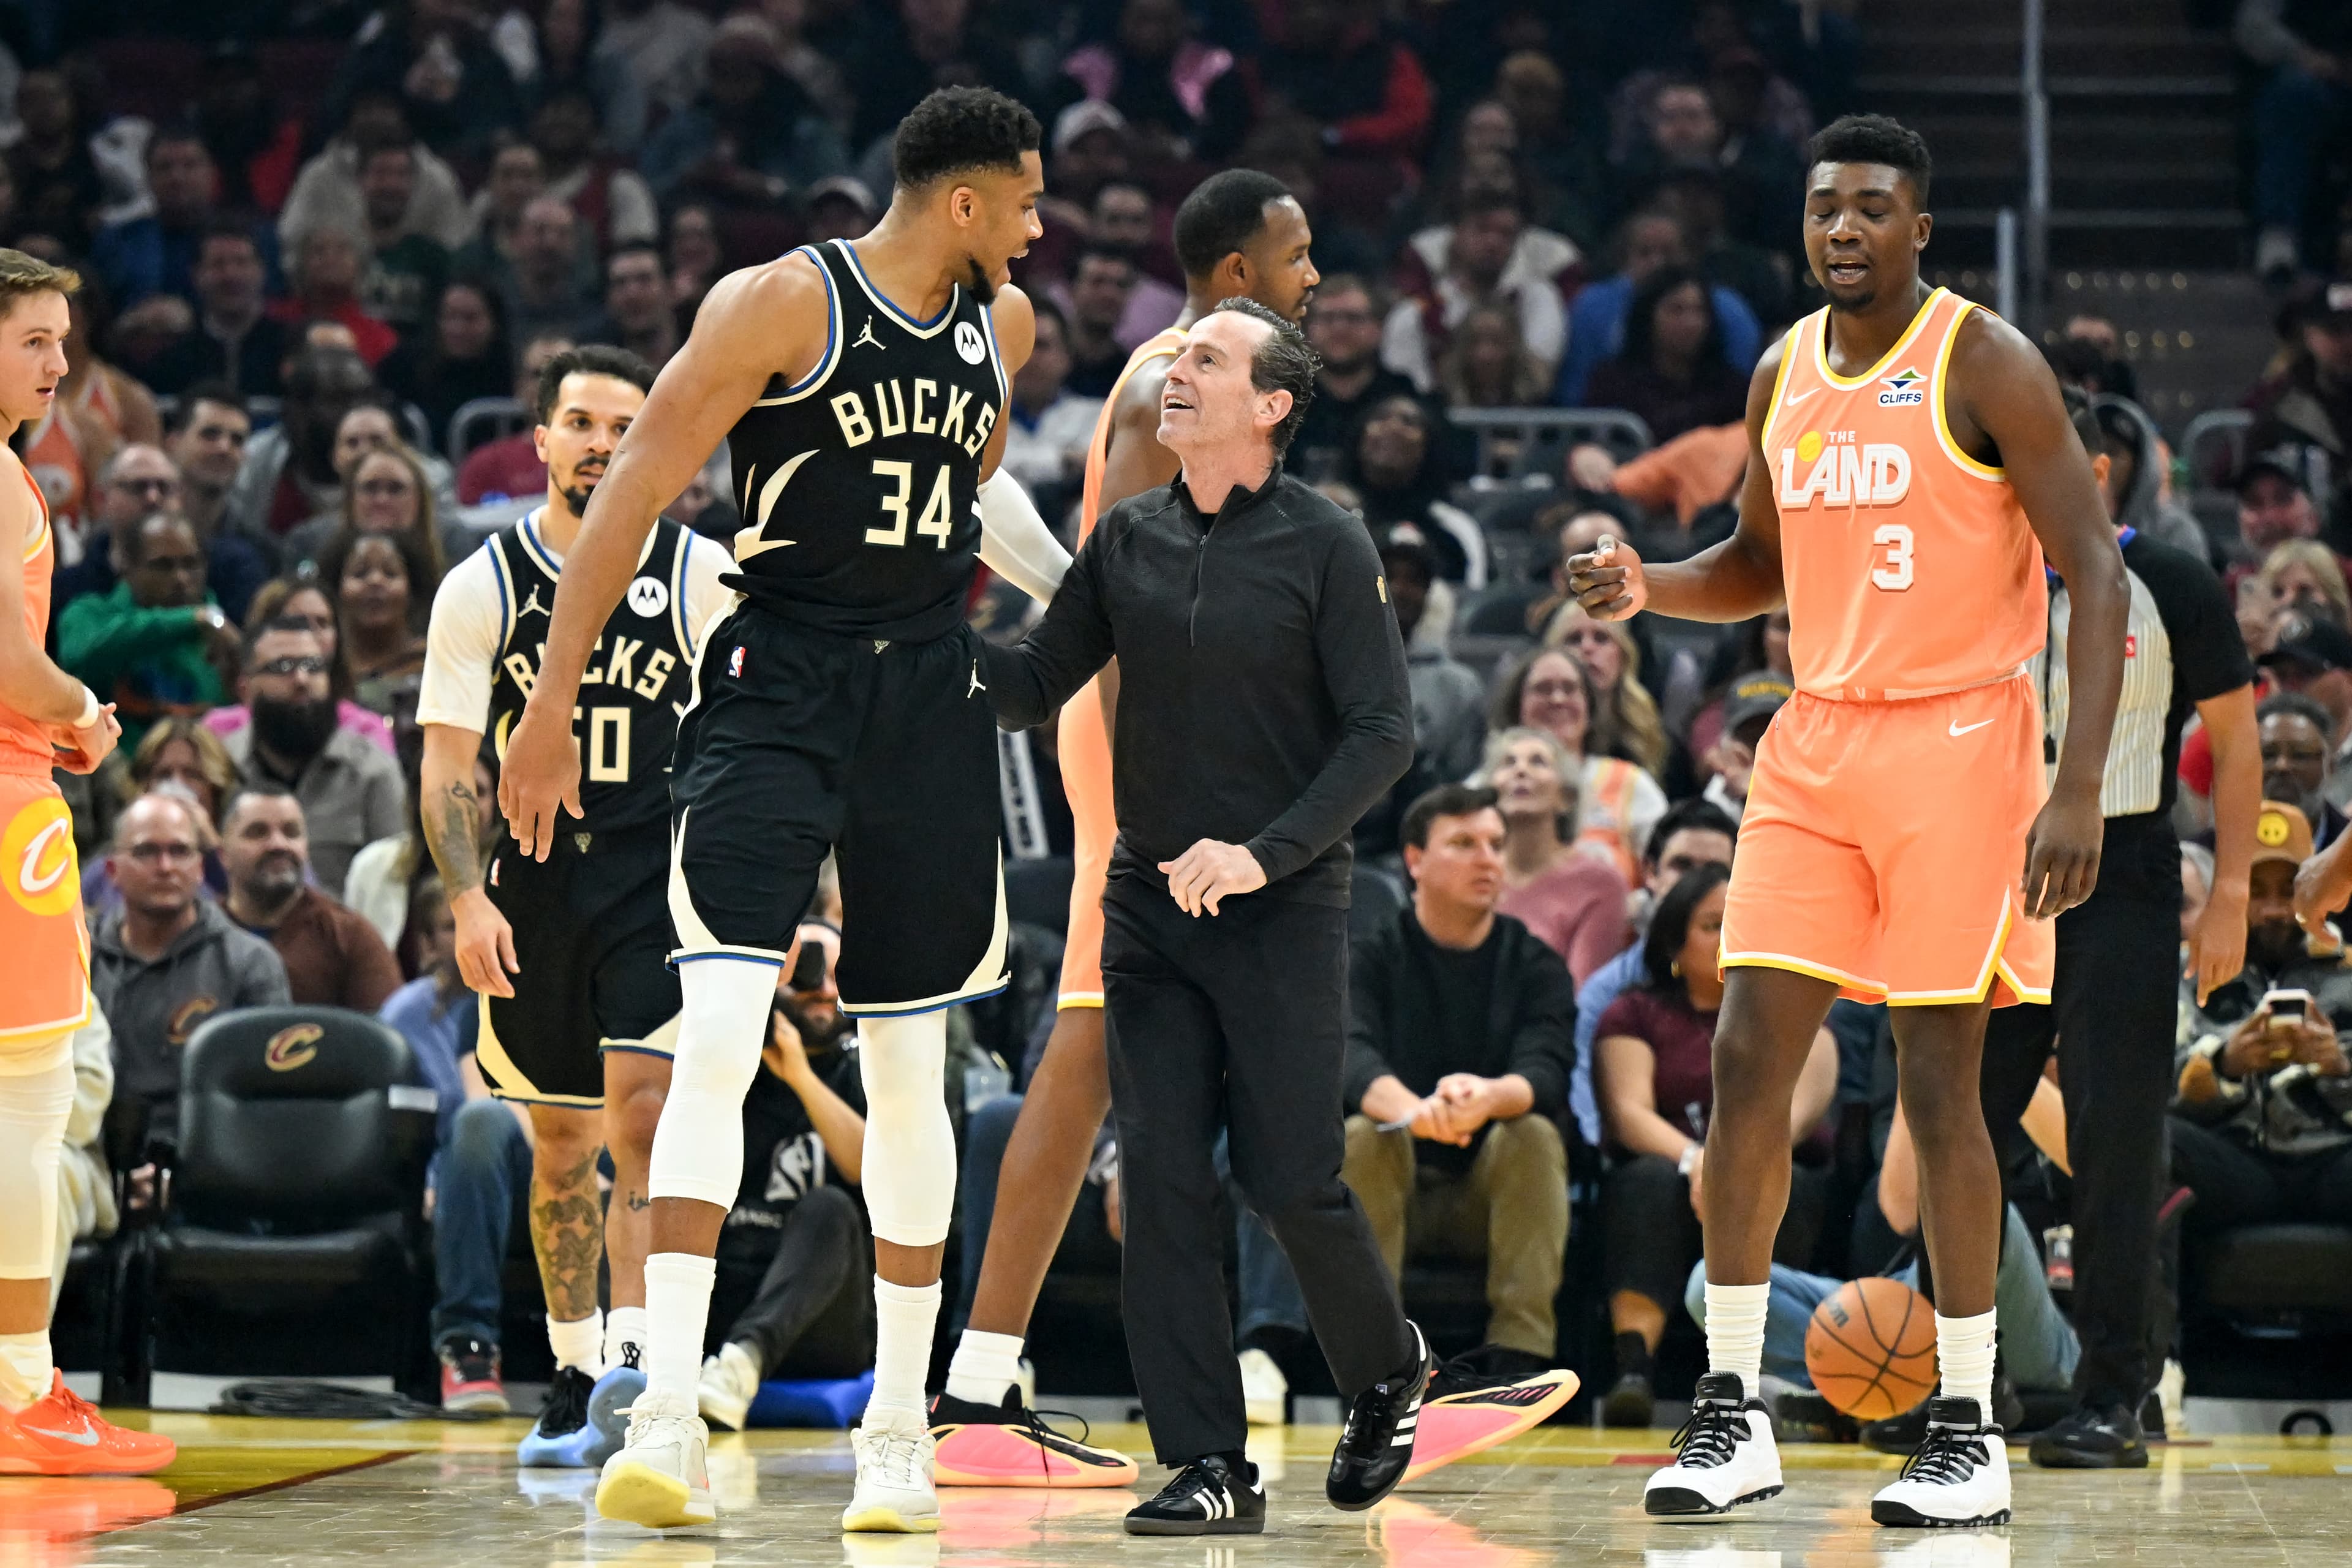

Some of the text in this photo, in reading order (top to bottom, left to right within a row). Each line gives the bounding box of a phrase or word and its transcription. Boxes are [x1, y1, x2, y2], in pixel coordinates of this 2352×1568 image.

[830, 377, 997, 459] BUCKS
[1880, 393, 1922, 404] CLIFFS
[1828, 431, 1856, 443] THE
[864, 459, 952, 549] 34
[1780, 443, 1912, 511] LAND
[1872, 524, 1914, 592] 3
[503, 635, 677, 701] BCKS
[572, 706, 631, 782] 0
